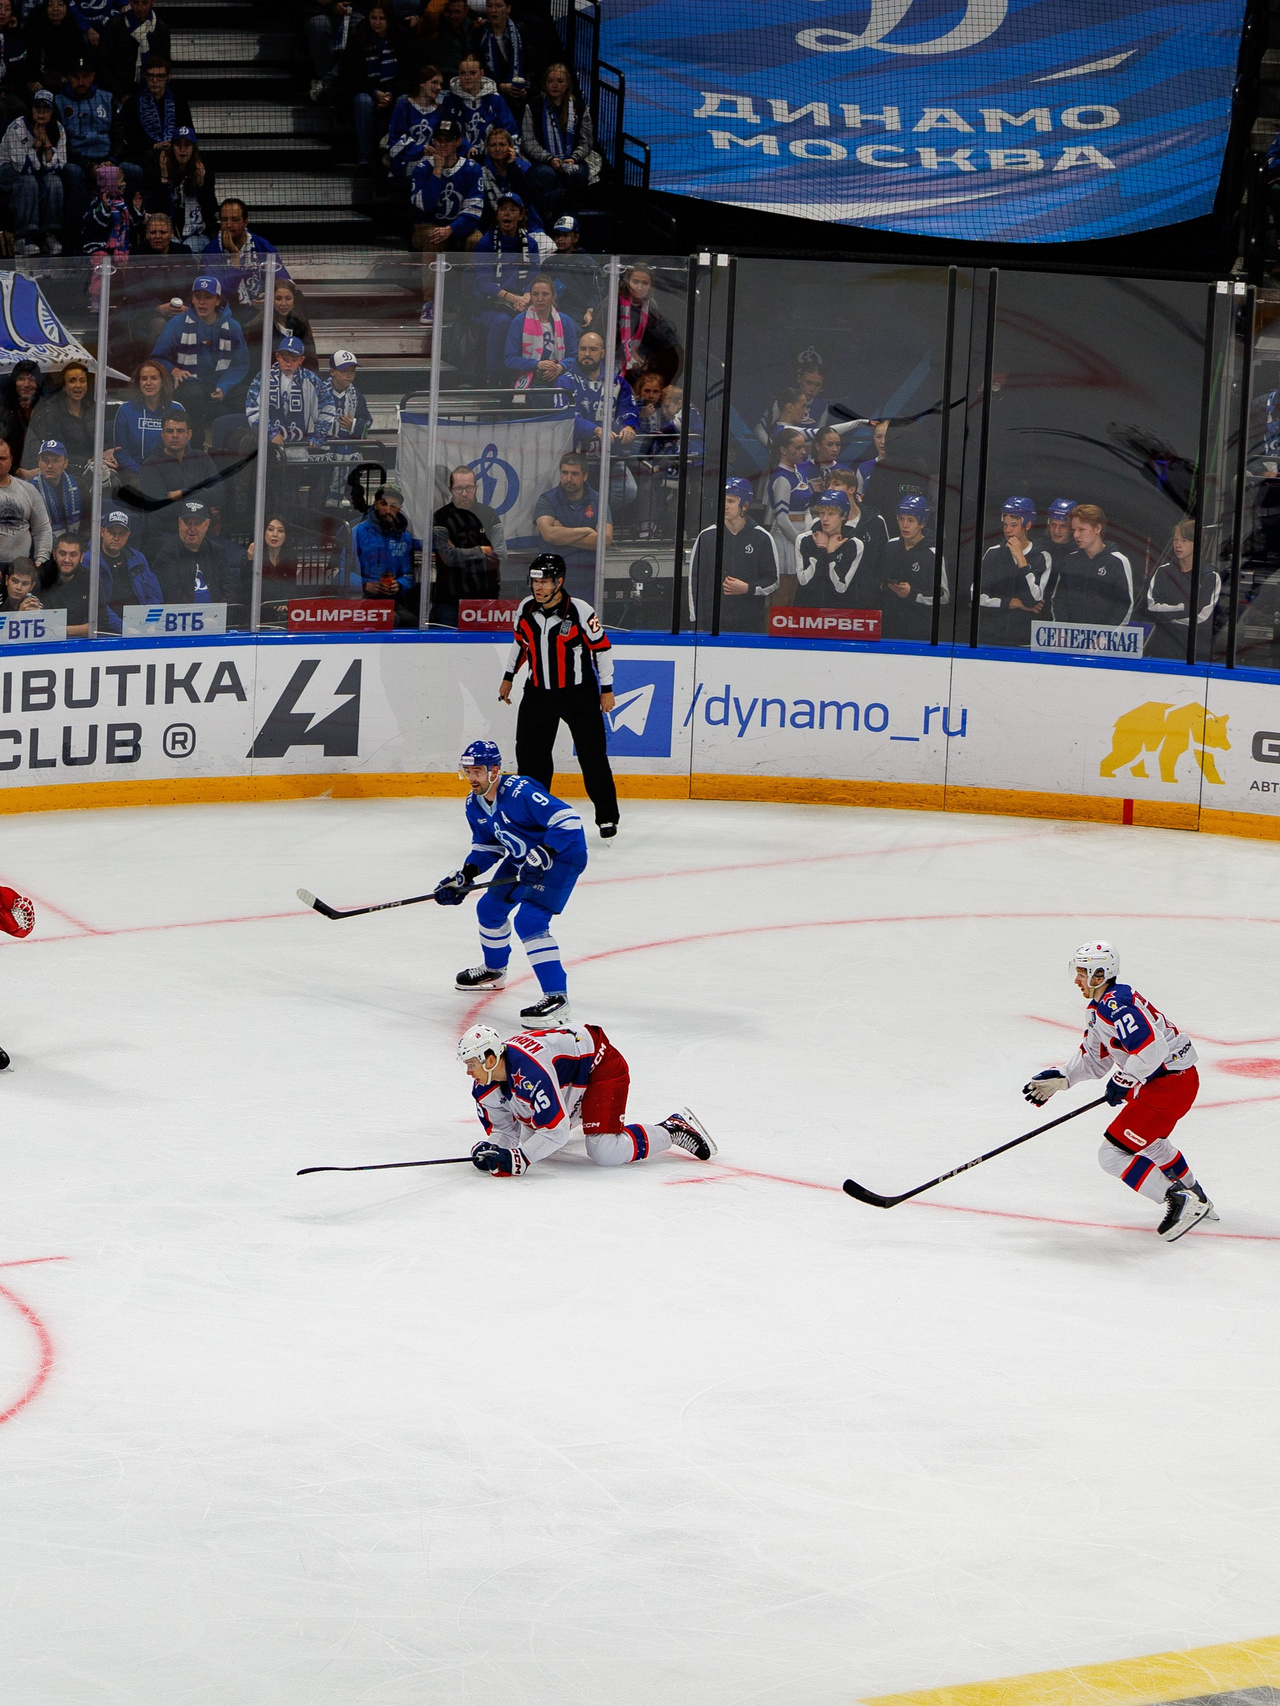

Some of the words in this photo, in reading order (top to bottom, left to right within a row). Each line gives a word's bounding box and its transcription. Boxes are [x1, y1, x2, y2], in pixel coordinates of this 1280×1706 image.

[693, 91, 1121, 134] ДИНАМО
[706, 129, 1117, 172] МОСКВА
[165, 611, 205, 632] ВТБ
[290, 609, 392, 622] OLIMPBET
[772, 614, 879, 632] OLIMPBET
[8, 618, 46, 640] ВТБ
[1035, 625, 1140, 653] СЕНЕЖСКАЯ
[683, 682, 968, 742] /dynamo_ru
[531, 791, 550, 807] 9
[500, 810, 511, 825] A
[1113, 1013, 1139, 1040] 72
[534, 1089, 551, 1114] 15
